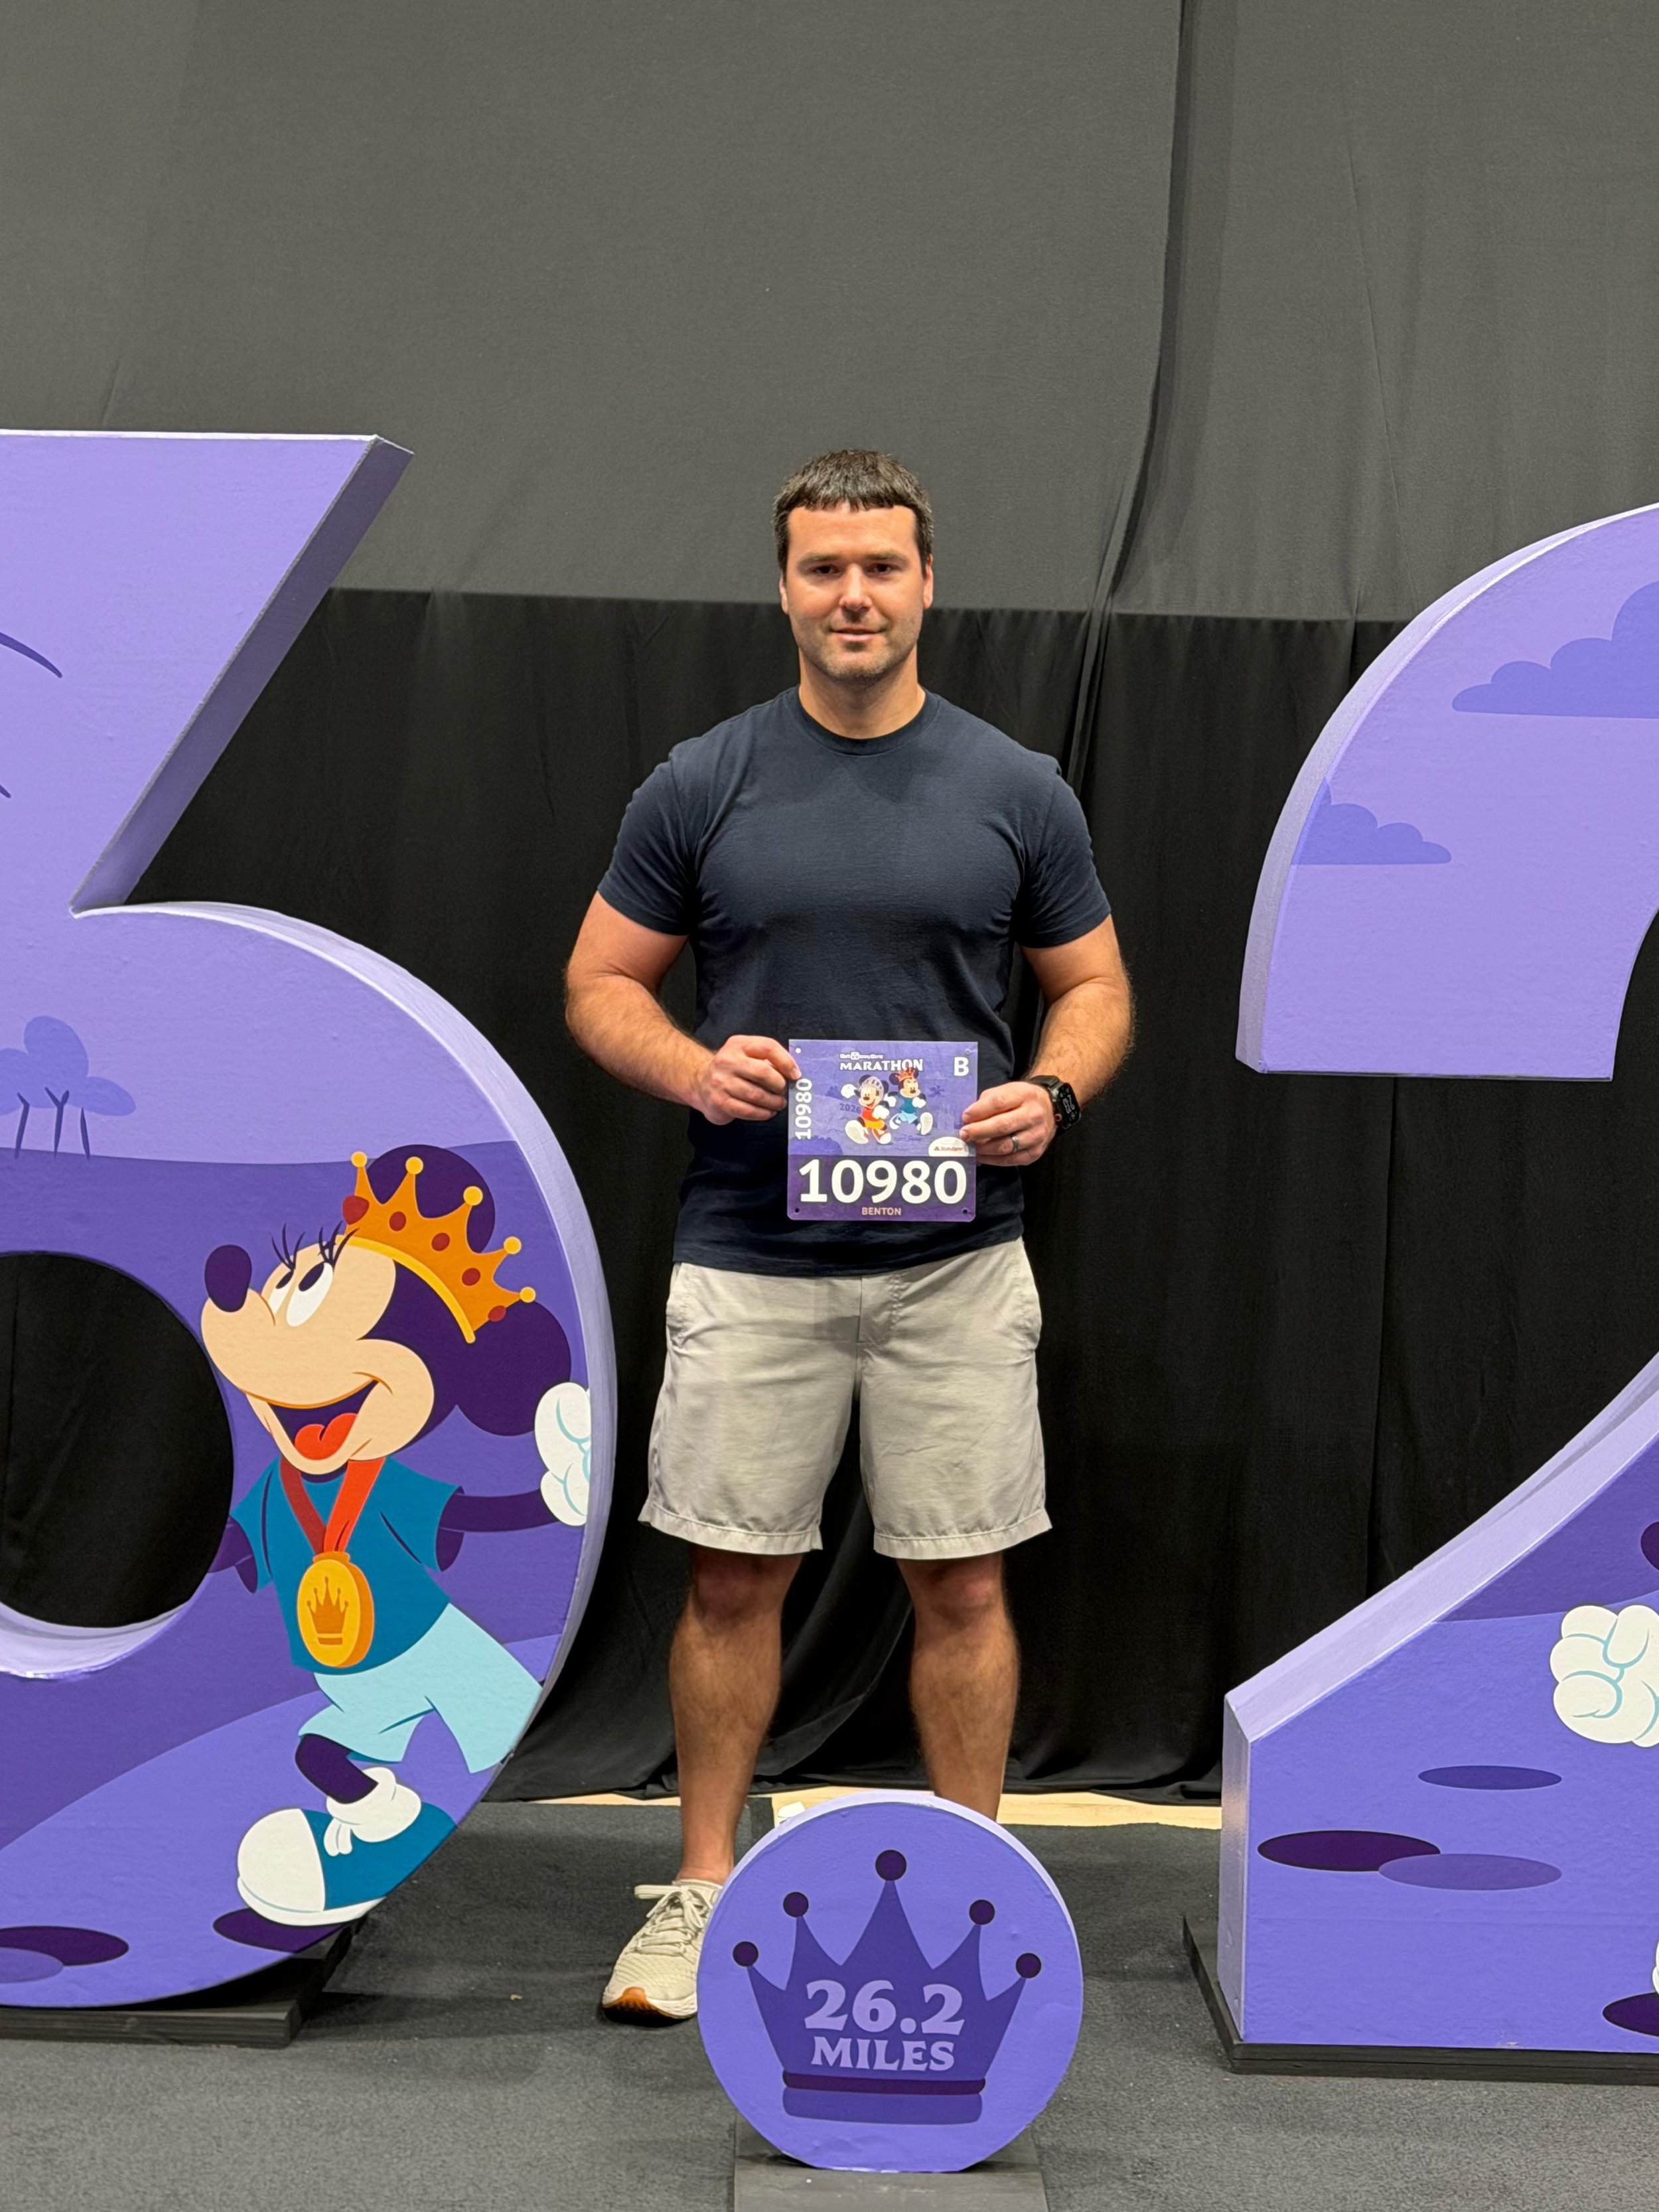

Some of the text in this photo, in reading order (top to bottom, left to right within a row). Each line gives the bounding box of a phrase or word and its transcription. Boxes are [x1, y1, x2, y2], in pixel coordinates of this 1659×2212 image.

[839, 1059, 924, 1071] MARATHON
[954, 1057, 970, 1076] B
[795, 1078, 812, 1140] 10980
[799, 1159, 967, 1204] 10980
[861, 1207, 901, 1216] BENTON
[804, 1979, 965, 2035] 26.2
[811, 2036, 955, 2071] MILES
